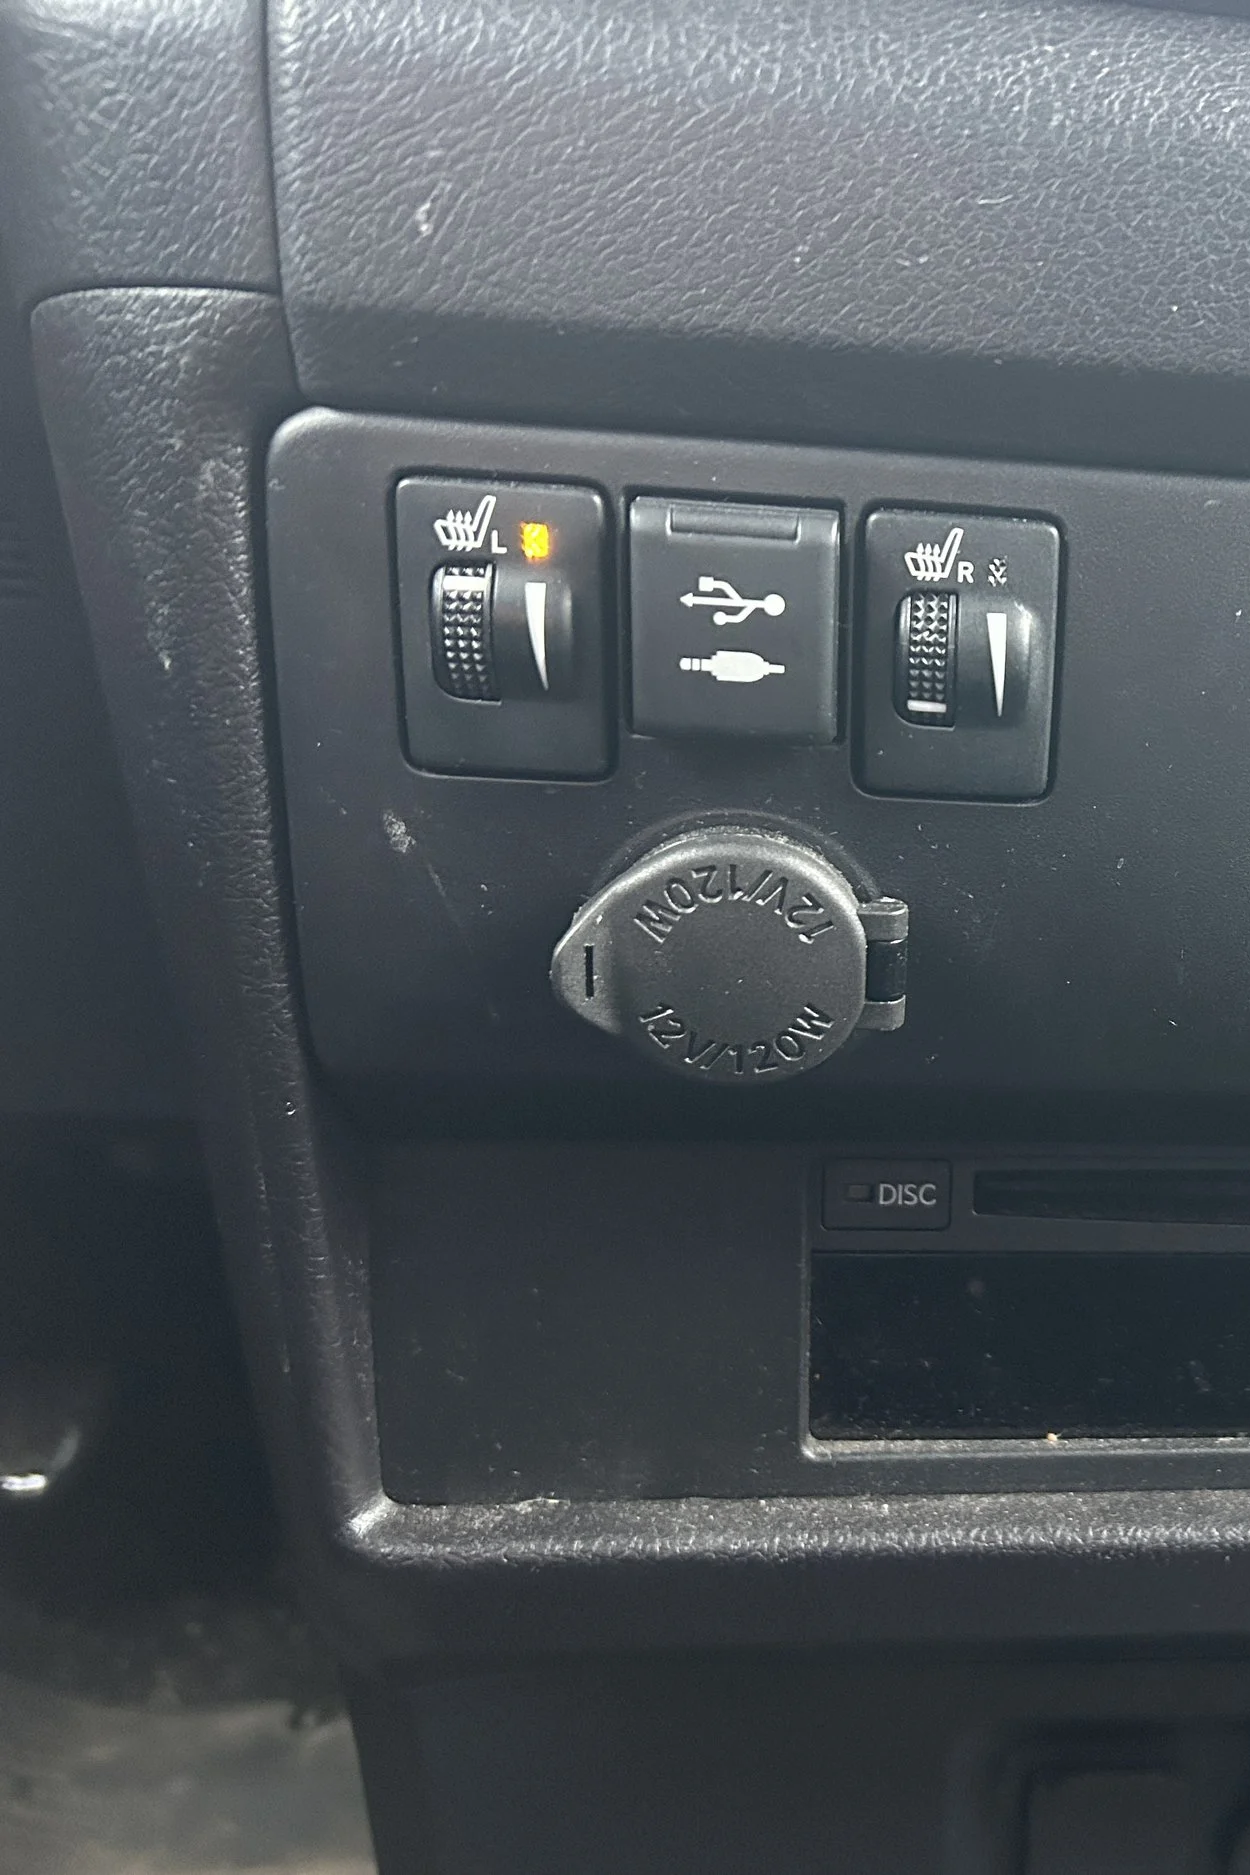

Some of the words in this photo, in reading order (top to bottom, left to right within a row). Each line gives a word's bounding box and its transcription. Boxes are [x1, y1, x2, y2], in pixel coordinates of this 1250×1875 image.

[491, 529, 508, 554] L
[957, 560, 975, 584] R
[633, 863, 836, 945] 12V/120W
[638, 1001, 837, 1075] 12V/120W
[878, 1183, 937, 1206] DISC
